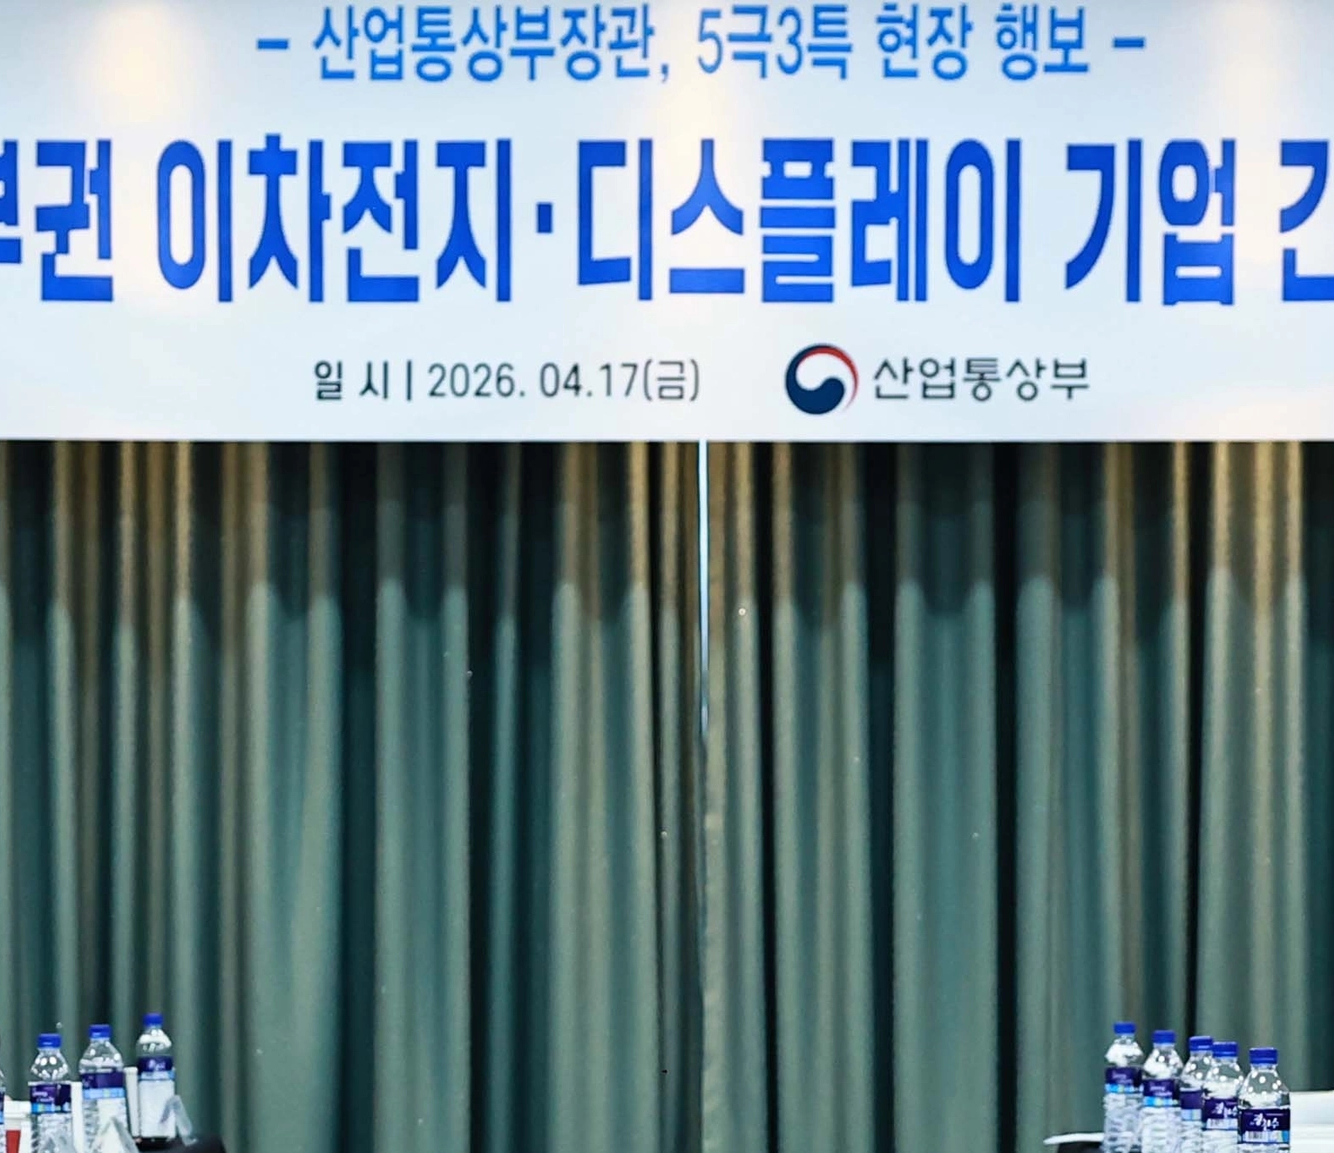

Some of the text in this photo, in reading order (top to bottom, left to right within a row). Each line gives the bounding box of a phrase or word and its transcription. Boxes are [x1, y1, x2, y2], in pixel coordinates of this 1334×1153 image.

[312, 2, 670, 84] 산업통상부장관,
[697, 3, 854, 81] 5극3특
[874, 1, 975, 82] 현장
[993, 1, 1091, 83] 행보
[156, 132, 1025, 306] 이차전지·디스플레이
[1063, 136, 1238, 308] 기업
[427, 362, 526, 399] 2026.
[539, 358, 701, 402] 04.17(금)
[873, 356, 1091, 403] 산업통상부
